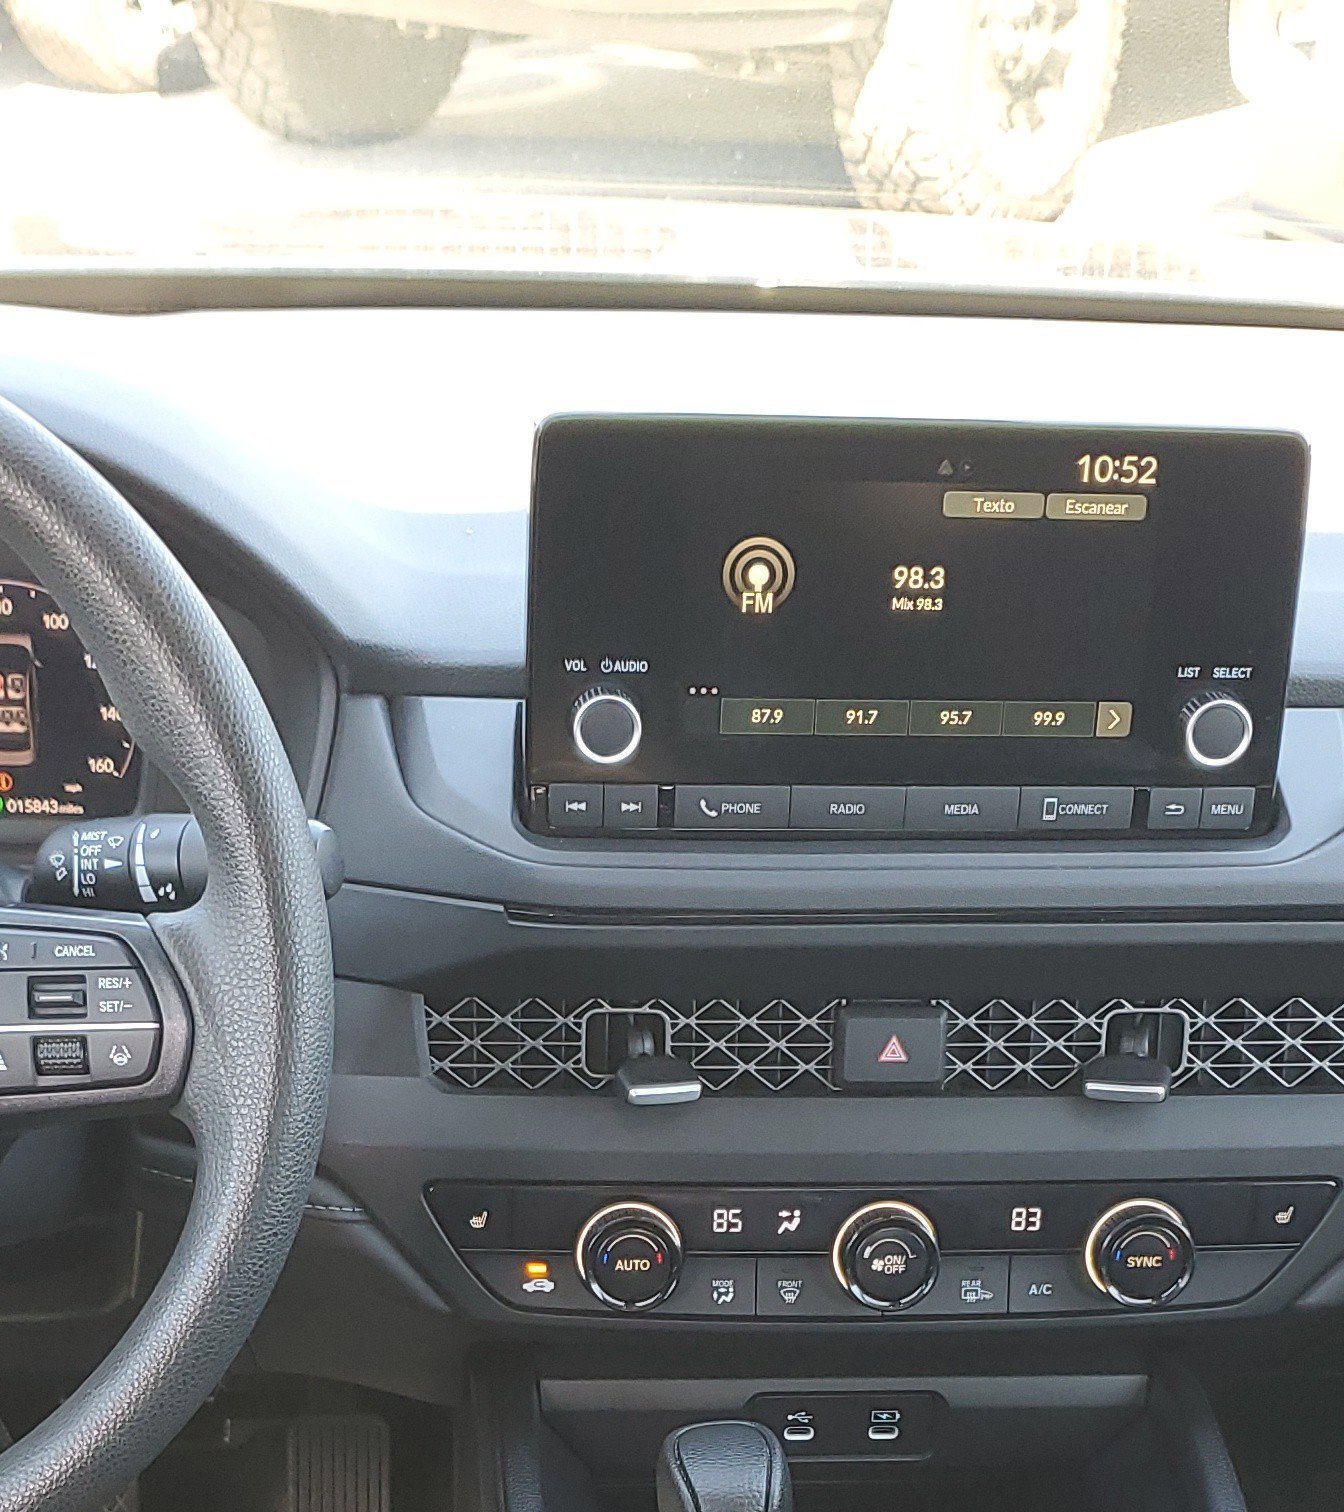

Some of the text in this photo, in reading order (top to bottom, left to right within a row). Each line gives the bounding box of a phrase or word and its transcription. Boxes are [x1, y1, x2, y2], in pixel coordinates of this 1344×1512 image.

[1078, 454, 1158, 485] 10:52
[973, 497, 1015, 514] Texto
[1065, 500, 1129, 516] Escanear
[893, 565, 946, 590] 98.3
[741, 592, 774, 613] FM
[892, 597, 943, 612] Mix 98.3
[42, 613, 70, 631] 100
[565, 658, 649, 673] VOL AUDIO
[1177, 666, 1253, 679] LIST SELECT
[751, 708, 783, 724] 87.9
[845, 709, 879, 726] 91.7
[939, 710, 973, 726] 95.7
[1032, 711, 1065, 727] 99.9
[88, 756, 115, 774] 160
[5, 797, 58, 815] 015843
[721, 803, 762, 815] PHONE
[829, 804, 865, 816] RADIO
[944, 804, 979, 816] MEDIA
[1058, 804, 1108, 816] CONNECT
[1210, 804, 1244, 816] MENU
[80, 830, 108, 841] MIST
[80, 845, 102, 856] OFF
[81, 859, 98, 871] INT
[81, 873, 96, 885] LO
[81, 887, 96, 898] HI
[54, 946, 96, 957] CANCEL
[712, 1208, 743, 1233] 85
[1010, 1206, 1042, 1231] 83
[615, 1259, 651, 1272] AUTO
[884, 1255, 906, 1265] ON/
[1126, 1255, 1163, 1268] SYNC
[884, 1264, 906, 1275] OFF
[712, 1280, 735, 1288] MODE
[777, 1280, 803, 1289] FRONT
[961, 1280, 981, 1288] REAR
[1028, 1283, 1053, 1296] A/C
